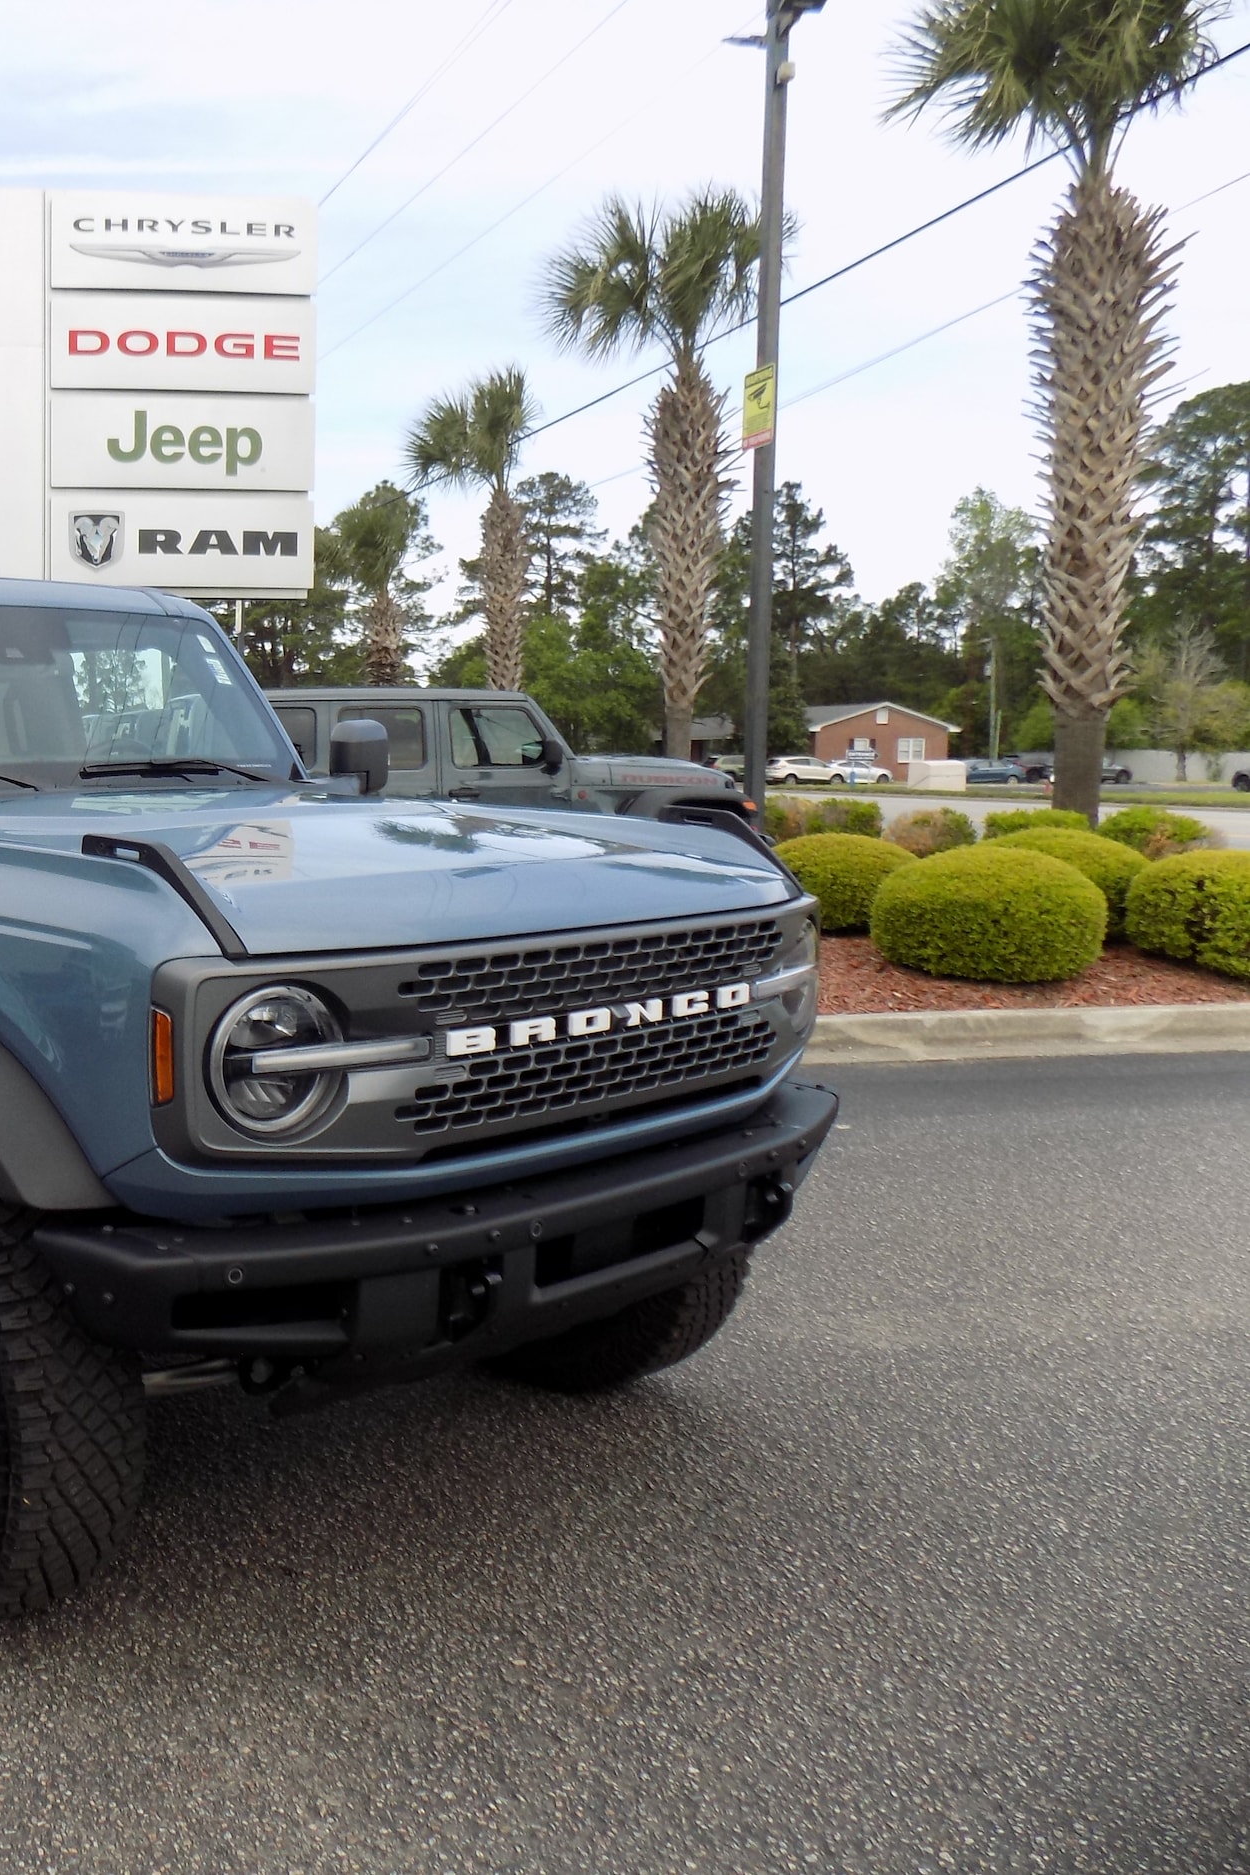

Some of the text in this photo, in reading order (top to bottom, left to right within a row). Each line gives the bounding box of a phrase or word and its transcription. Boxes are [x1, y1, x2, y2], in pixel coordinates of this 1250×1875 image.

[73, 218, 295, 239] CHRYSLER
[68, 330, 300, 361] DODGE
[106, 410, 263, 476] Jeep
[138, 529, 298, 557] RAM
[621, 774, 718, 785] RUBICON
[446, 982, 751, 1057] BRONCO
